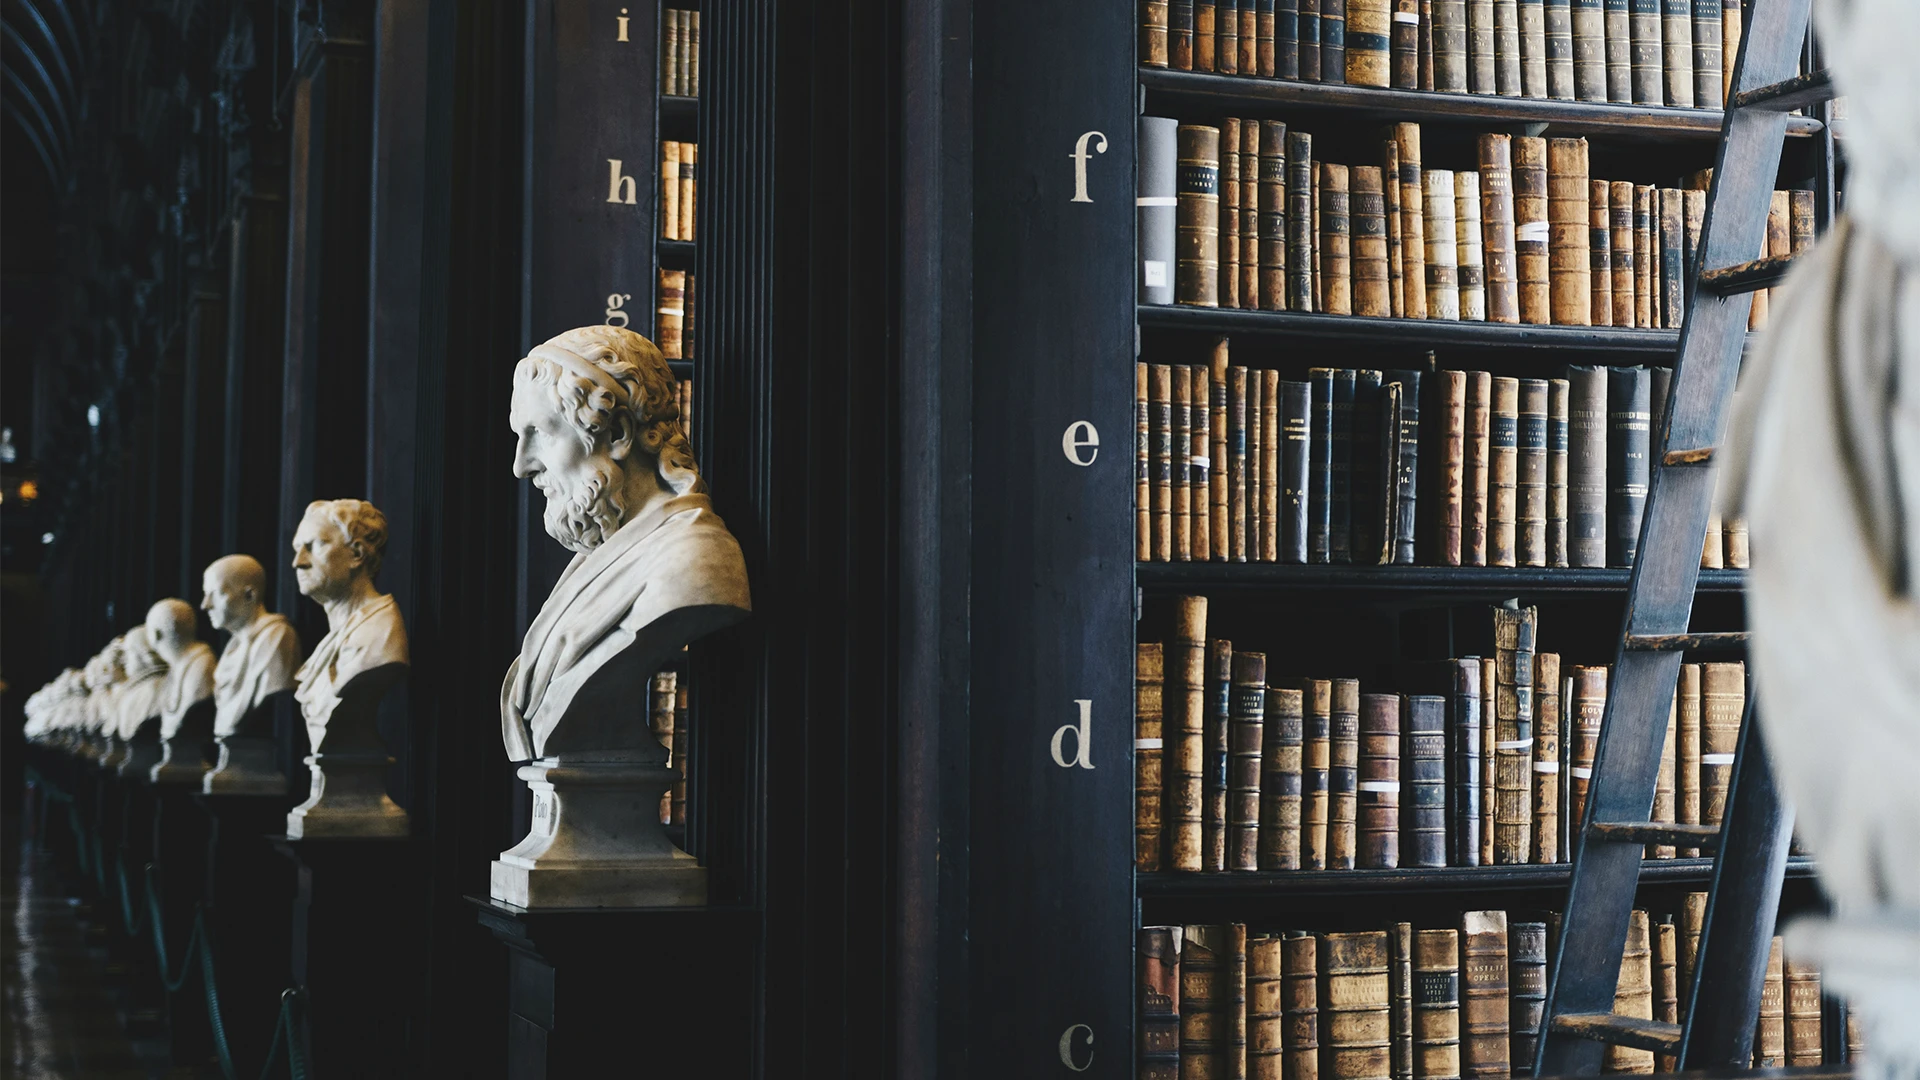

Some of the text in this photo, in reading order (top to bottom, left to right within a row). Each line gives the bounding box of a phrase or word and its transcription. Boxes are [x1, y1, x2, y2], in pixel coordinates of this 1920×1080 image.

[616, 8, 630, 42] i
[606, 159, 637, 205] h
[1068, 131, 1108, 203] f
[605, 293, 631, 328] g
[1062, 420, 1100, 467] e
[1051, 699, 1095, 770] d
[1577, 717, 1600, 725] BIBL
[1473, 974, 1500, 982] OPERA
[1059, 1022, 1095, 1073] c
